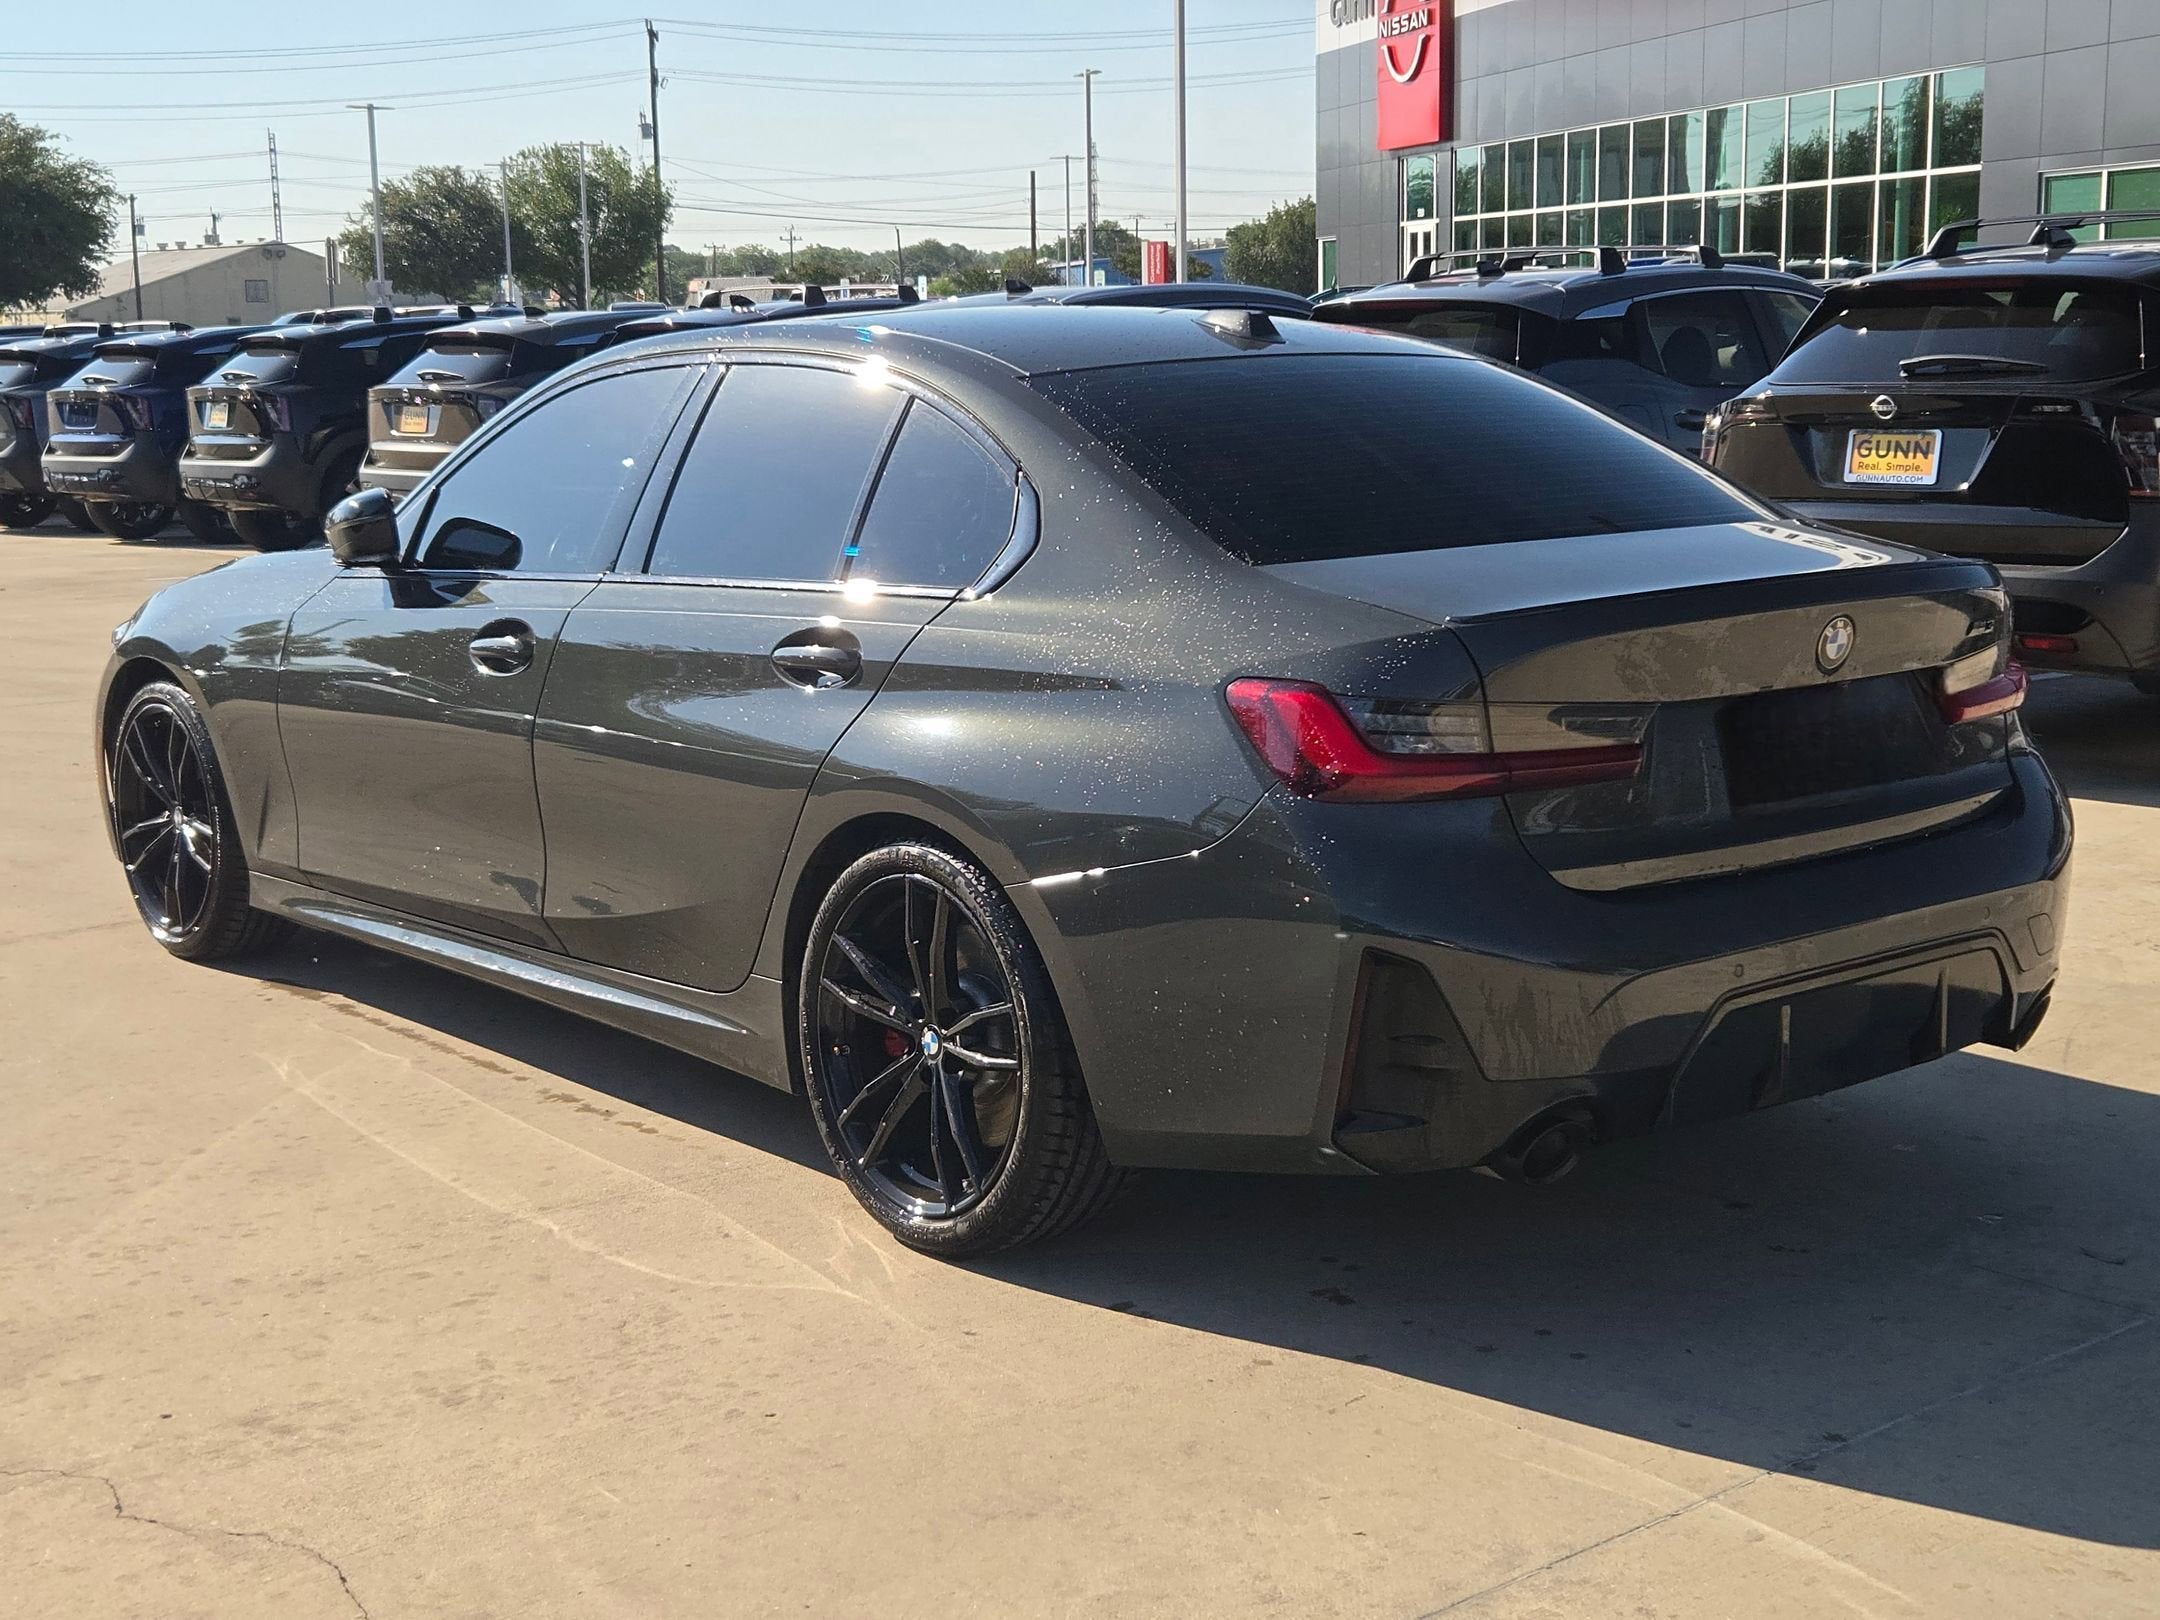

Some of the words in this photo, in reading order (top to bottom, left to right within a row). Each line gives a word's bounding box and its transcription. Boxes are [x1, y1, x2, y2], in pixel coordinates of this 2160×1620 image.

[1379, 8, 1428, 38] NISSAN
[1857, 439, 1931, 460] GUNN
[1857, 461, 1882, 471] Real.
[1886, 462, 1924, 473] Simple.
[1856, 474, 1924, 483] GUNNAUTO.COM
